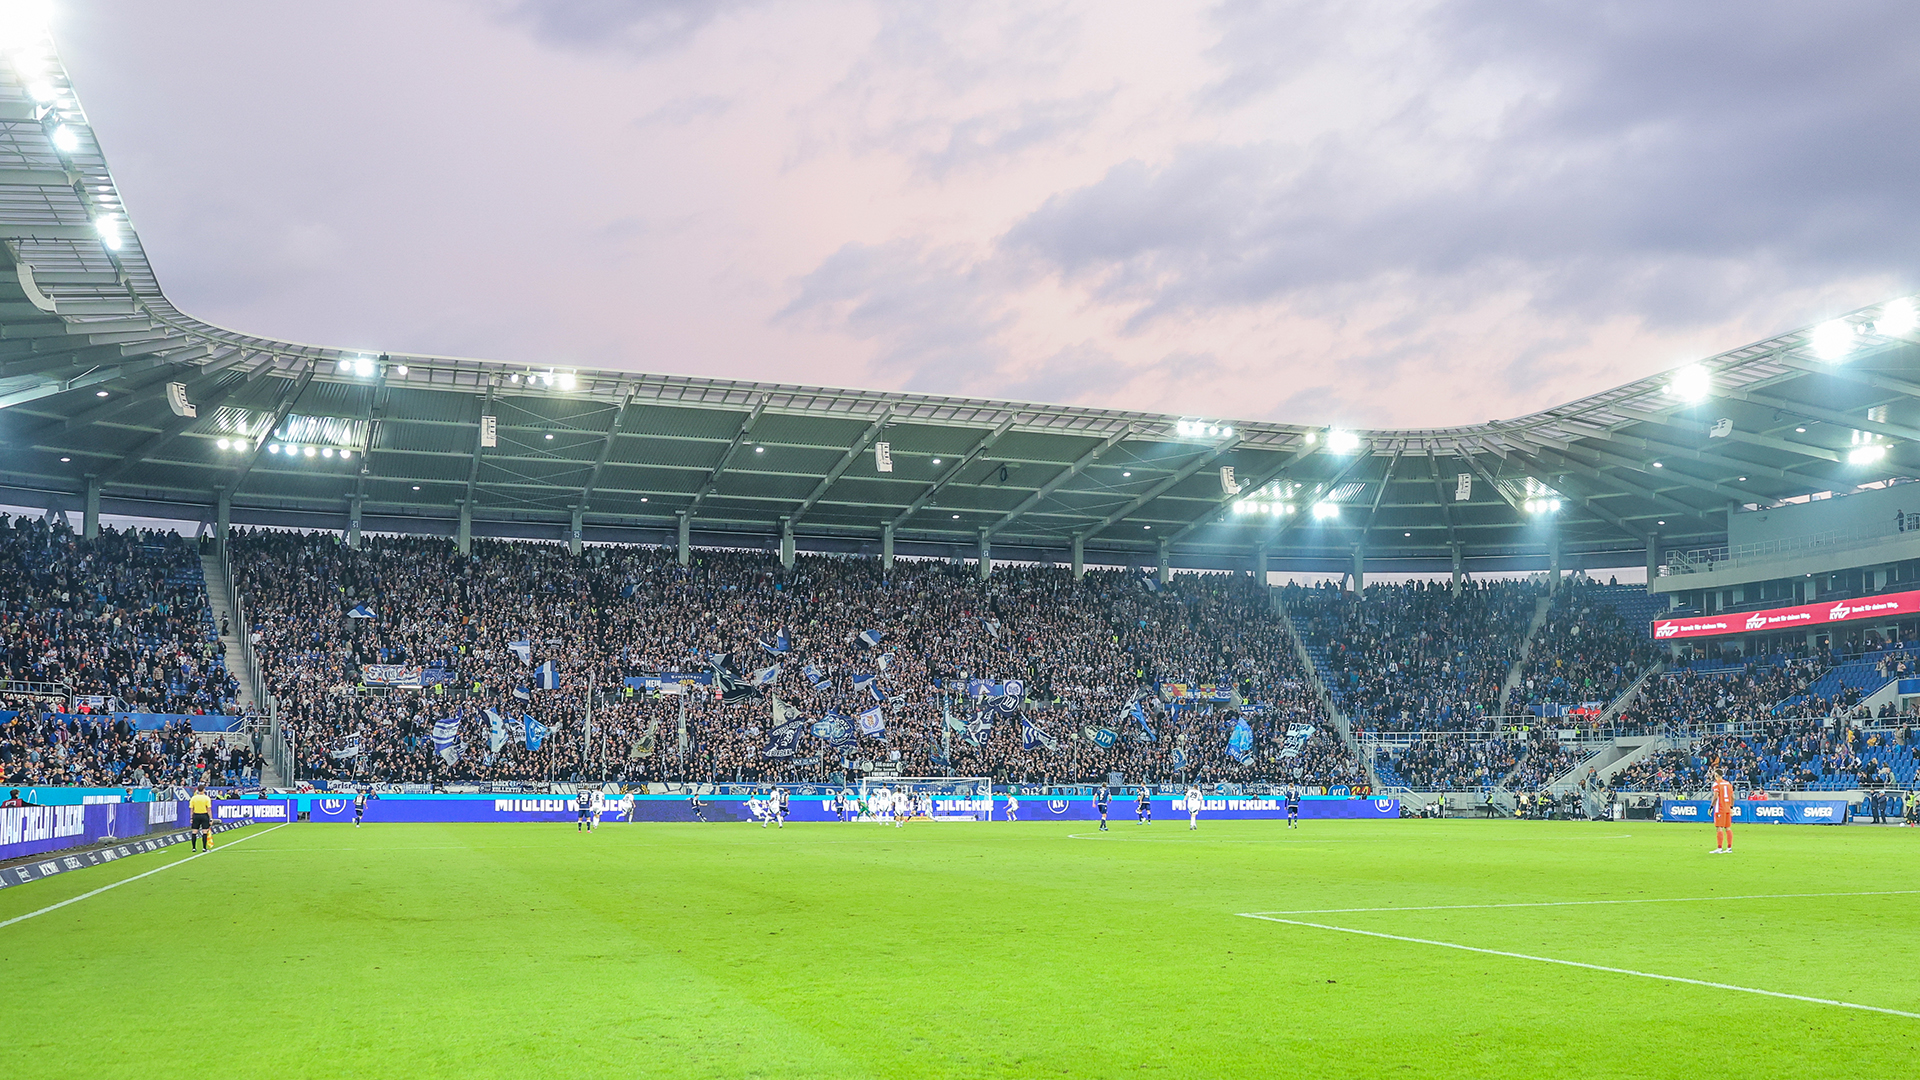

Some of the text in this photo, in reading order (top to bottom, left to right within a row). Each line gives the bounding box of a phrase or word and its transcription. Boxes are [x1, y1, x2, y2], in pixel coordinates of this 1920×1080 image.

[494, 799, 565, 812] MITGLIED
[1670, 805, 1697, 816] SWEG
[1756, 806, 1784, 817] SWEG
[1804, 806, 1833, 817] SWEG
